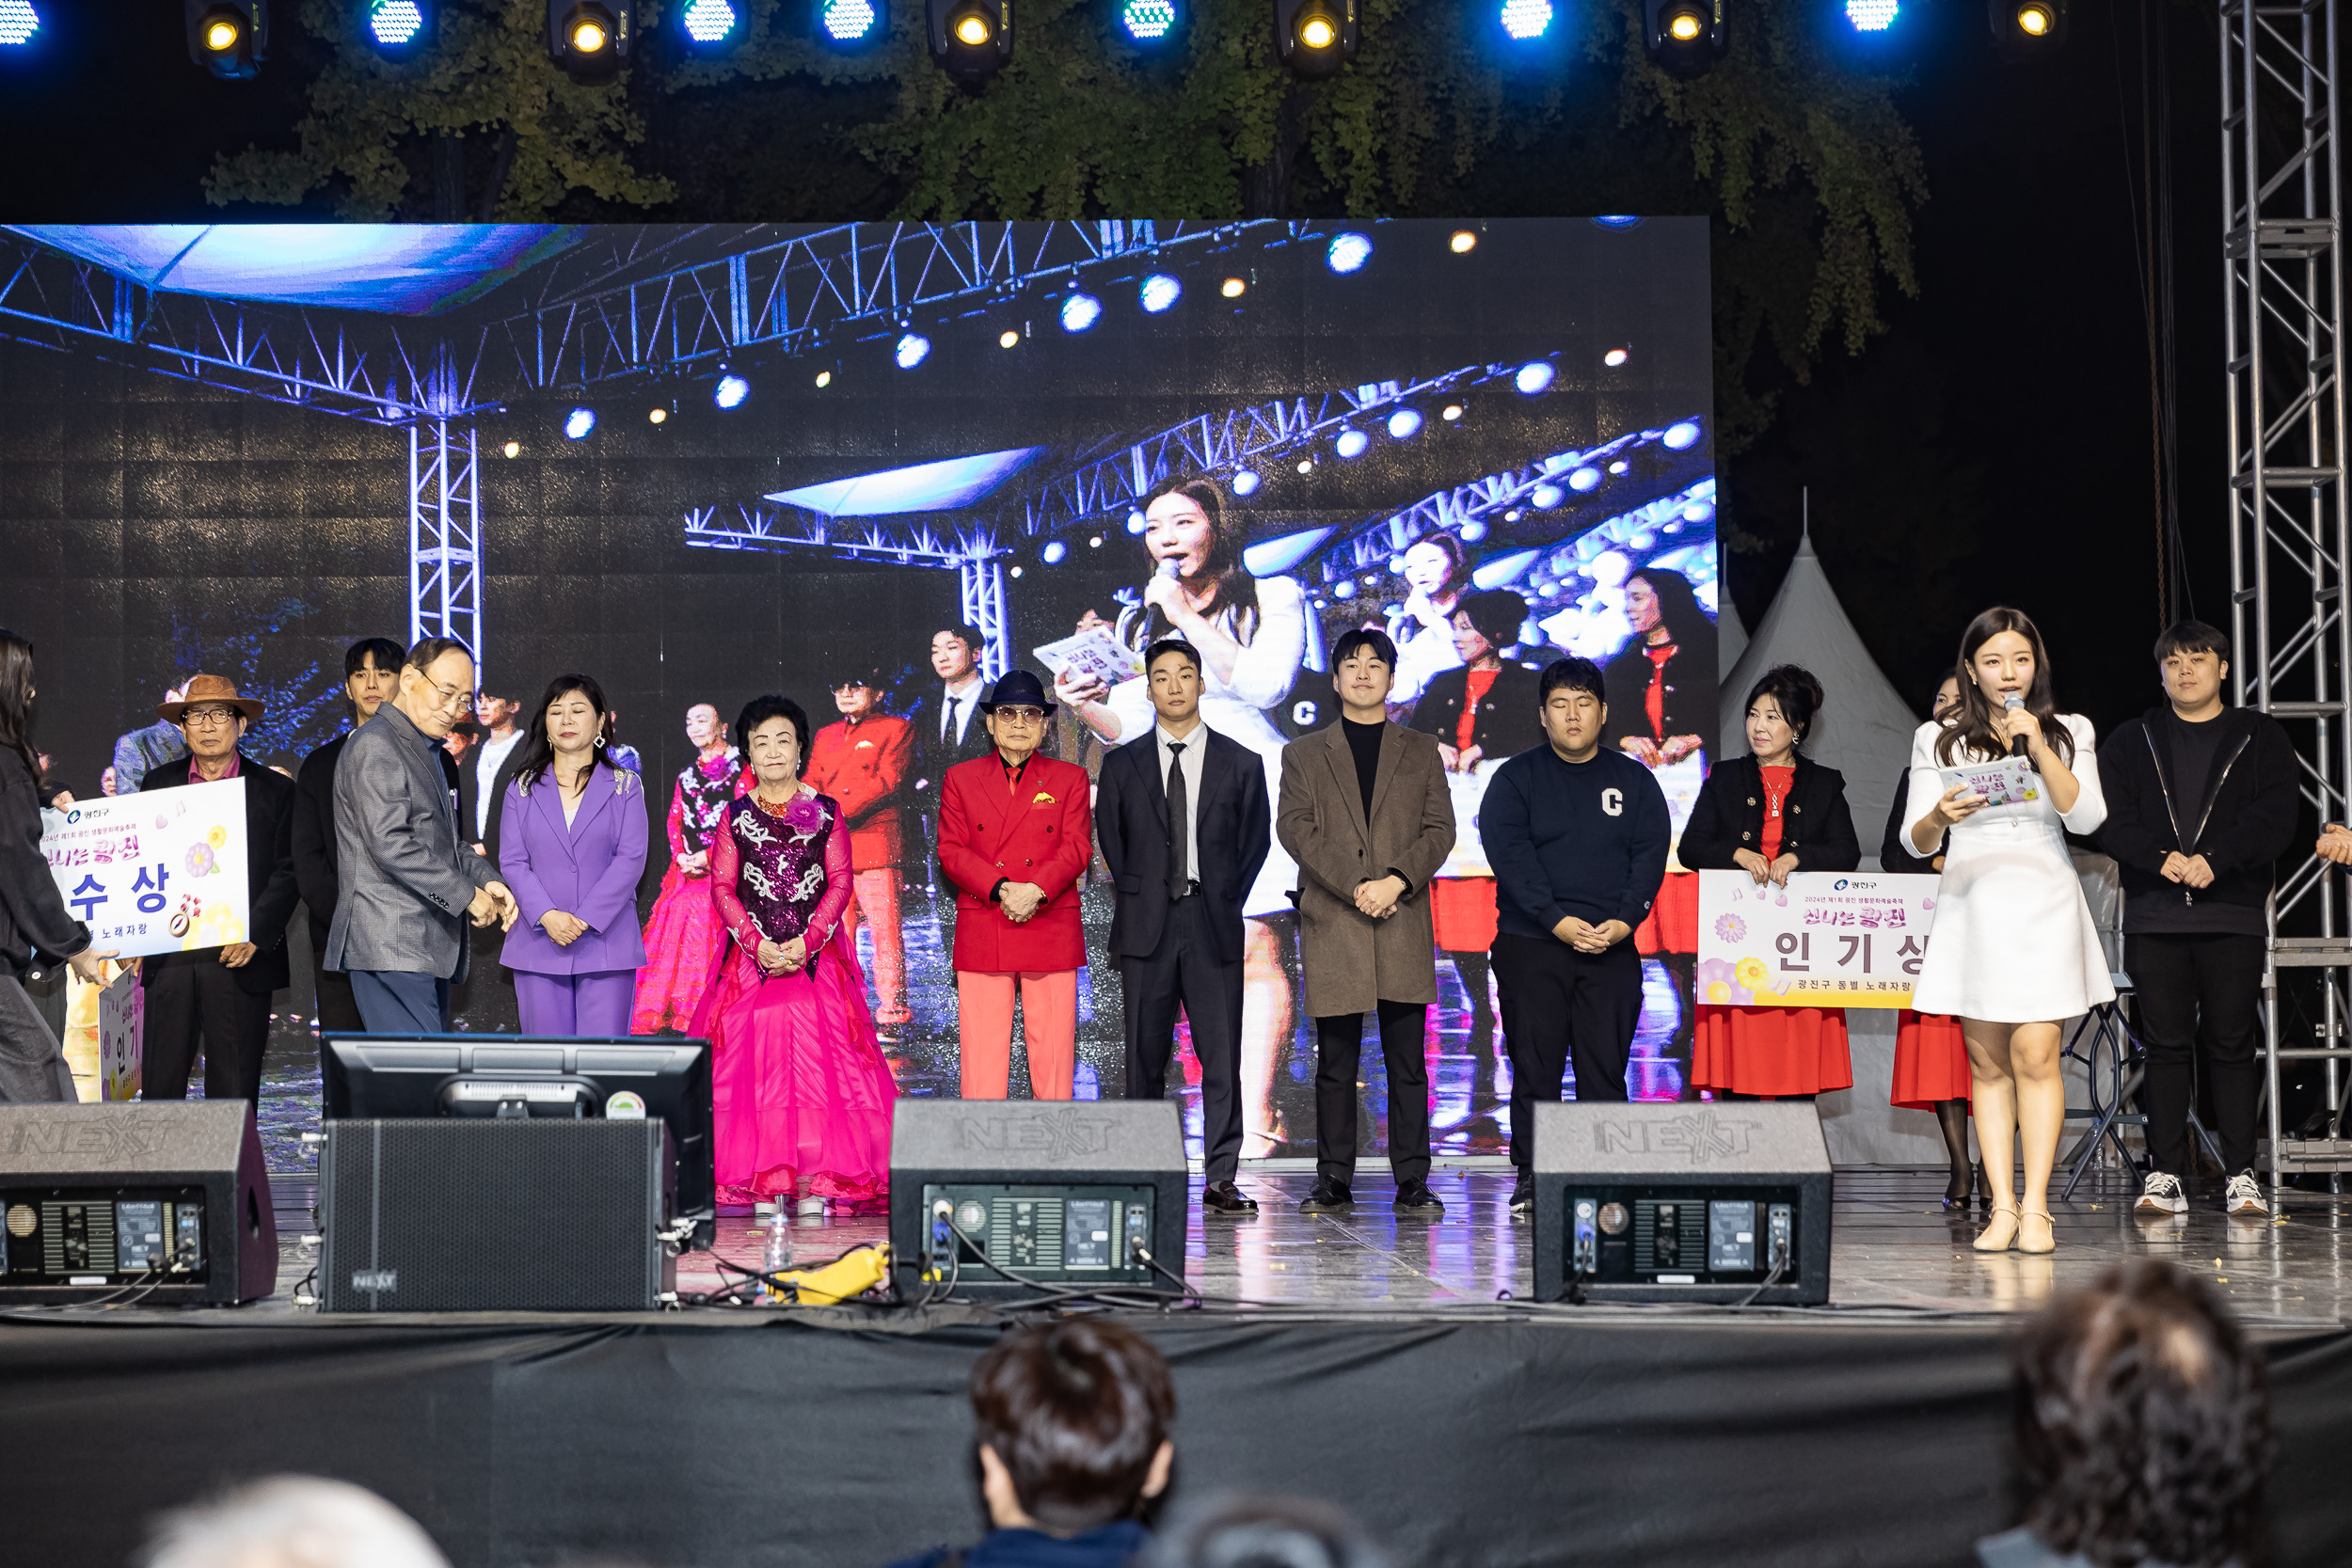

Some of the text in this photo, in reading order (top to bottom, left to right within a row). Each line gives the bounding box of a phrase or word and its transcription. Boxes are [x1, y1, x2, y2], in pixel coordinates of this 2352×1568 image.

[1293, 701, 1317, 725] C
[1601, 787, 1623, 816] C
[1851, 881, 1877, 890] 광진구
[1803, 906, 1907, 928] 신나는 광진
[102, 923, 148, 939] 노래자랑
[1798, 979, 1911, 991] 광진구 동별 노래자랑
[13, 1111, 175, 1163] NEXT
[954, 1108, 1120, 1161] NEXT
[1594, 1110, 1762, 1164] NEXT
[353, 1272, 396, 1290] NEXT
